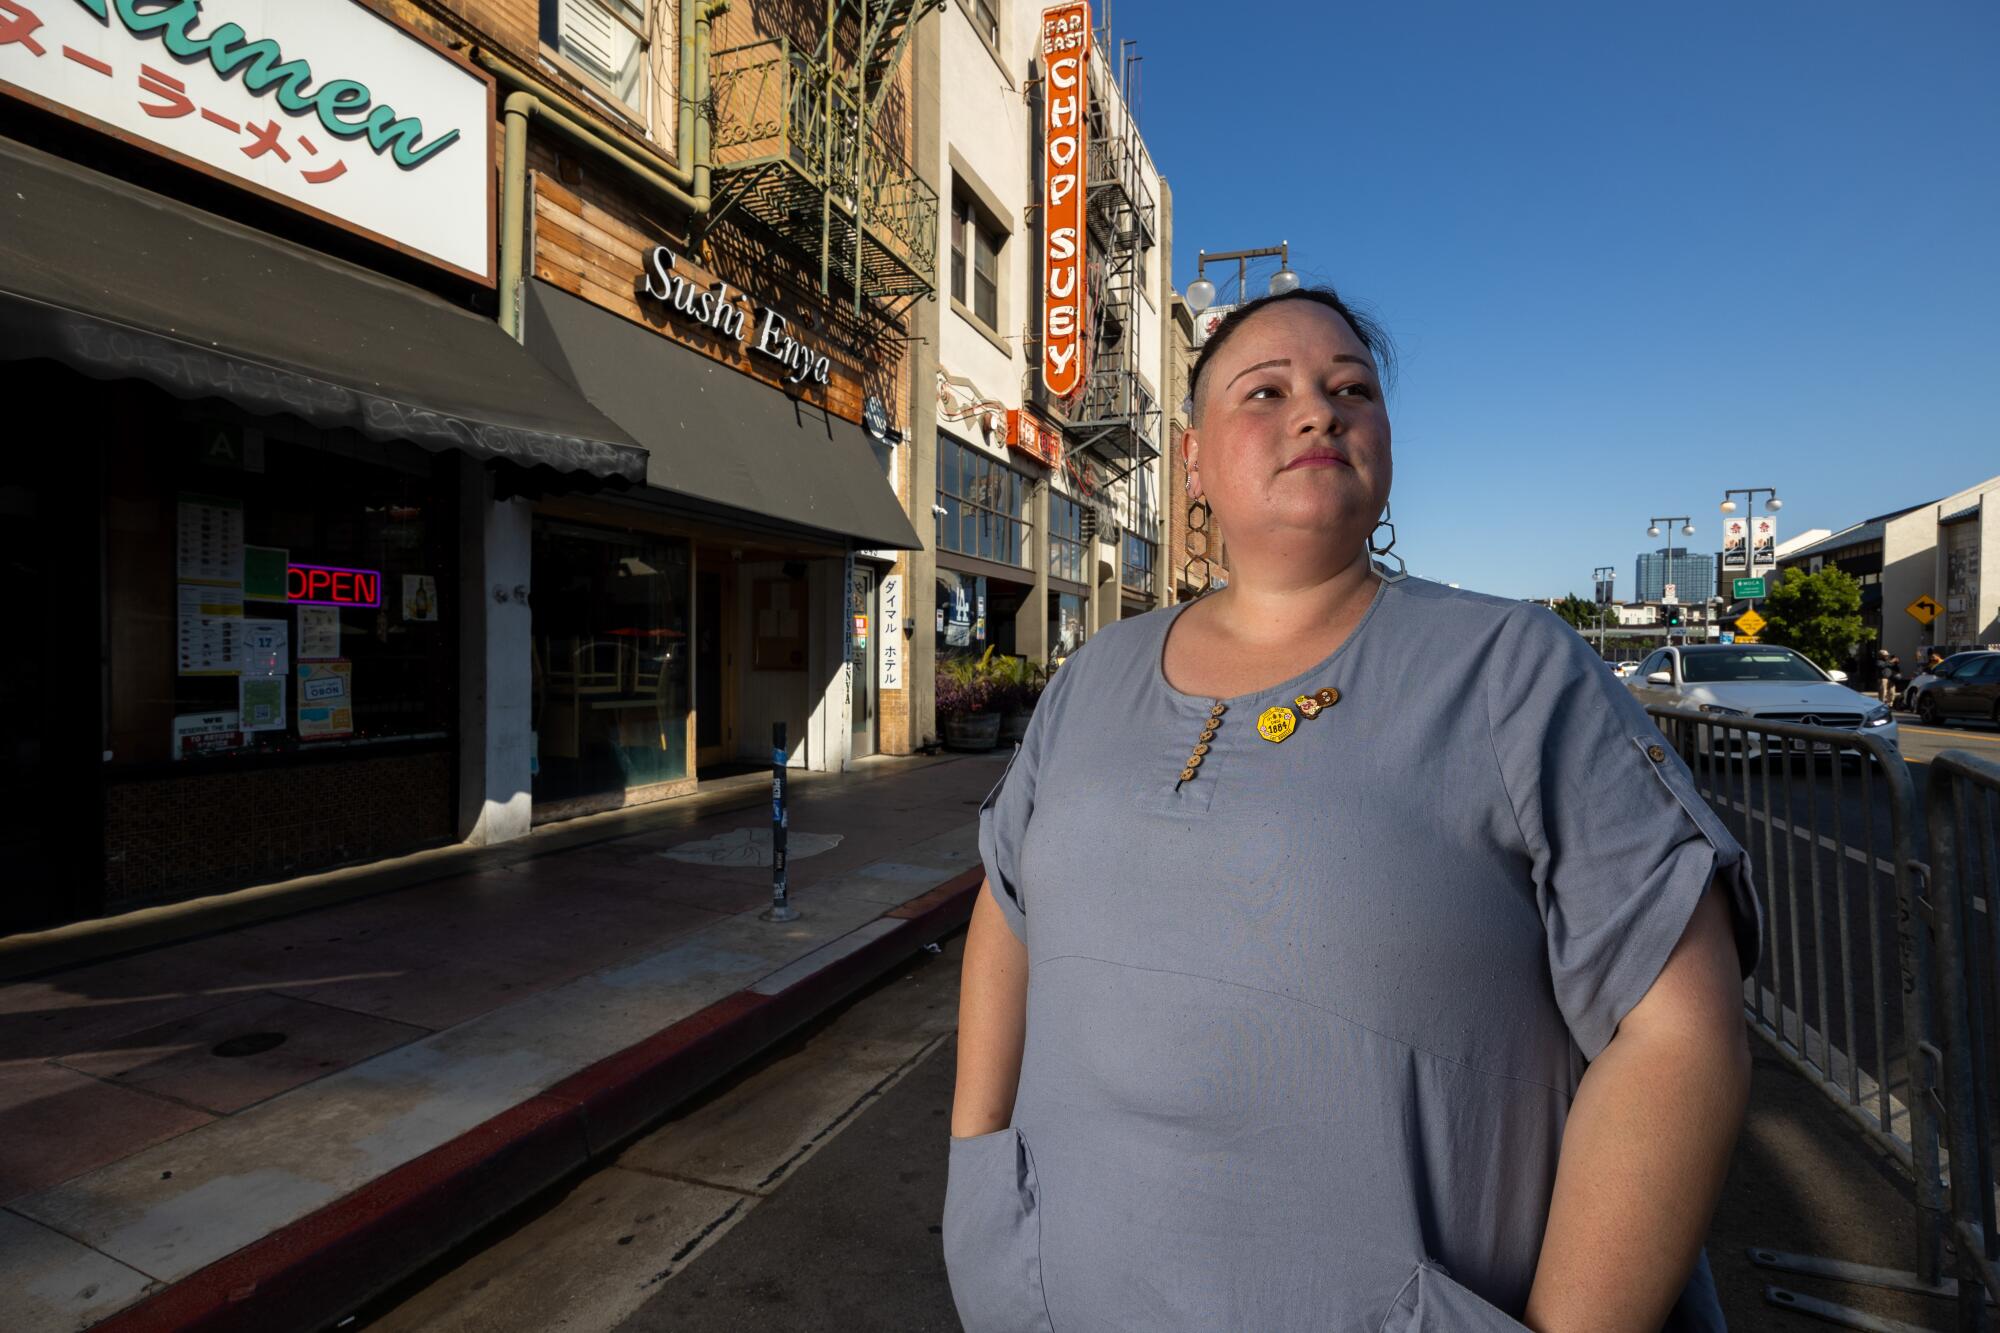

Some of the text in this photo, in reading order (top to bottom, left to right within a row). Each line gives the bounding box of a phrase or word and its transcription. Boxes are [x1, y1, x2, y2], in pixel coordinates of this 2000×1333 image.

[1044, 31, 1084, 54] EAST
[1045, 15, 1081, 37] FAR
[73, 0, 460, 168] amen
[1049, 58, 1077, 376] CHOP SUEY
[645, 246, 831, 385] Sushi Enya
[209, 432, 236, 460] A
[288, 568, 376, 602] OPEN
[956, 586, 969, 621] LA
[258, 638, 272, 648] 17
[884, 579, 897, 684] ダイマル ホテル
[1268, 721, 1287, 733] 1884
